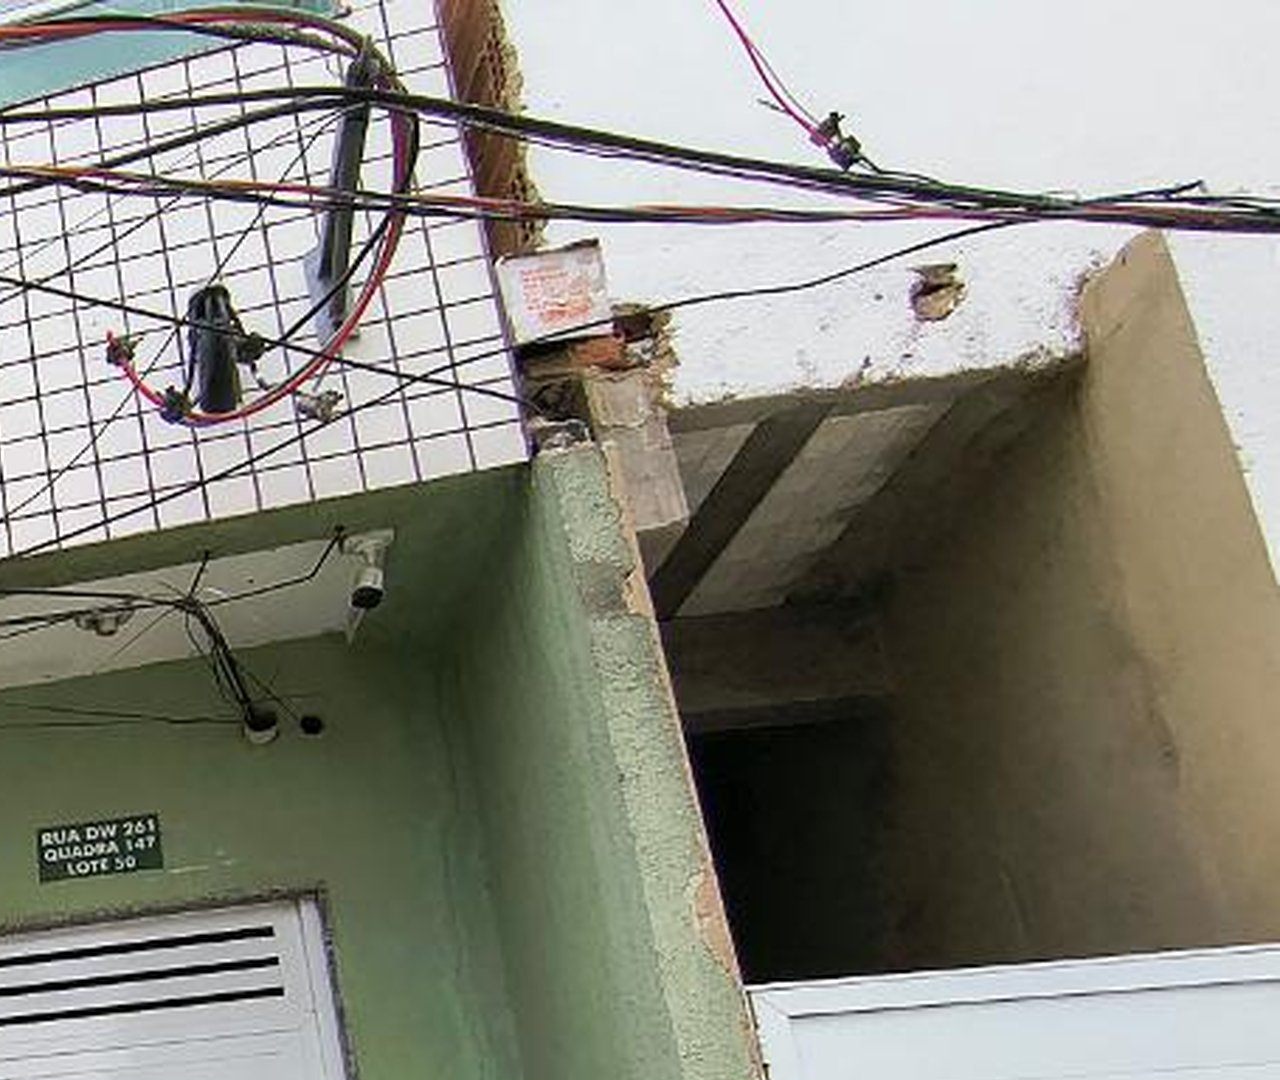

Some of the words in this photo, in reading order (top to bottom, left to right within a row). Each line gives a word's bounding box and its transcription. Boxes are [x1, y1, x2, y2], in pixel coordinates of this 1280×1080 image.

[41, 829, 80, 846] RUA
[86, 824, 117, 840] DW
[123, 818, 155, 836] 261
[44, 841, 119, 862] QUADRA
[126, 835, 155, 851] 147
[67, 858, 108, 875] LOTE
[114, 855, 136, 871] 50
